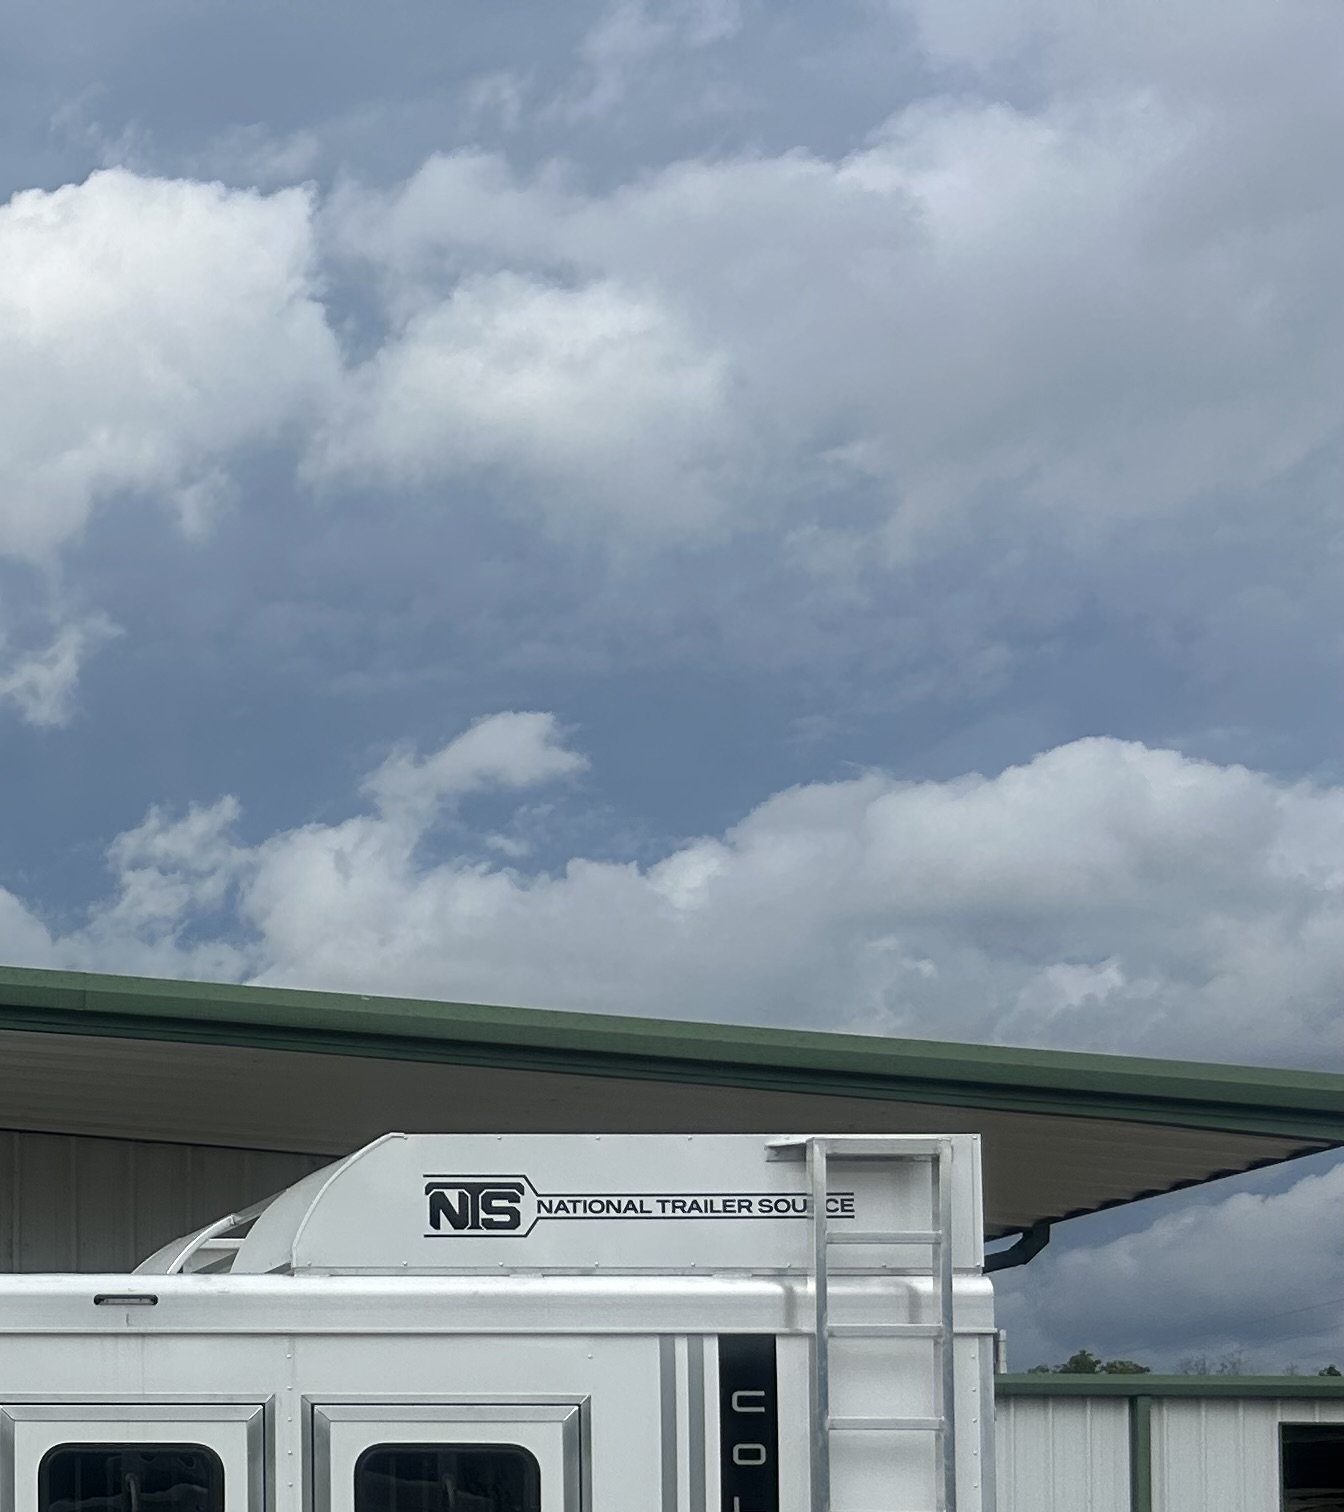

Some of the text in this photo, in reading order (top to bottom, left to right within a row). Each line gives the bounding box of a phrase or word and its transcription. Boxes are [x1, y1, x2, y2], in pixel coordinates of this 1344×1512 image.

[424, 1181, 525, 1231] NTS
[537, 1198, 855, 1215] NATIONAL TRAILER SOUCE
